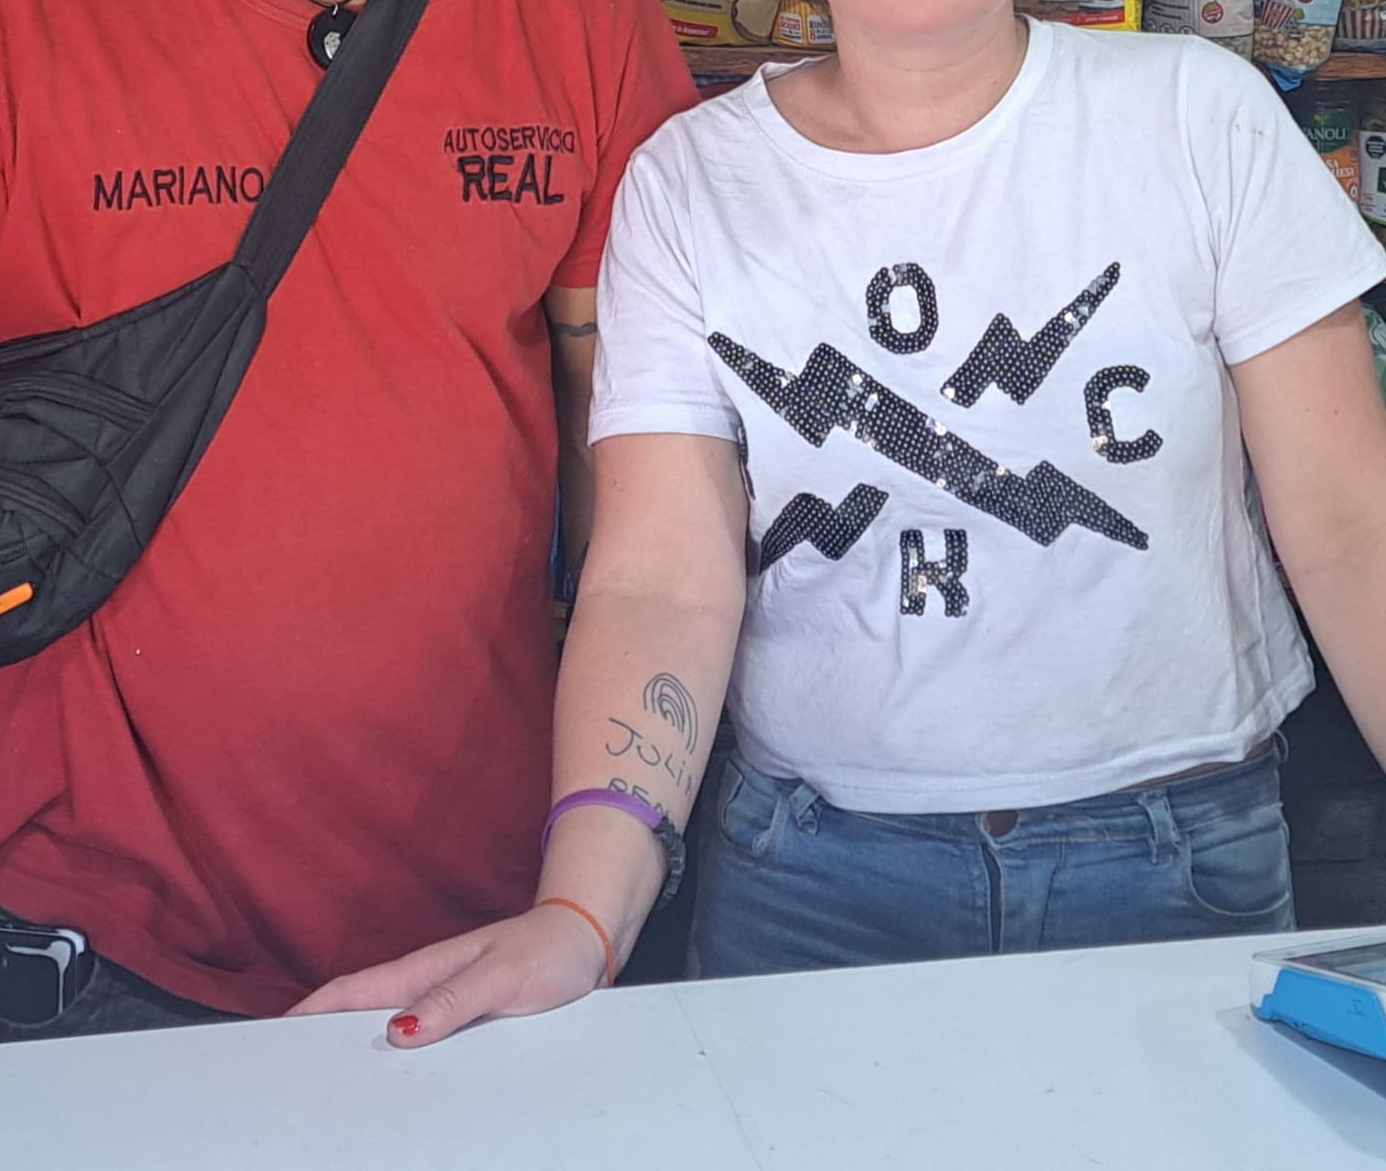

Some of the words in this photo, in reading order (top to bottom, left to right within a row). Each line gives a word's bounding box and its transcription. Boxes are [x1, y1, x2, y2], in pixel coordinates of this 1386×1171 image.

[442, 125, 577, 156] AUTOSERVICIO
[92, 164, 266, 213] MARIANO
[456, 154, 565, 207] REAL
[865, 261, 940, 356] O
[1083, 363, 1164, 465] C
